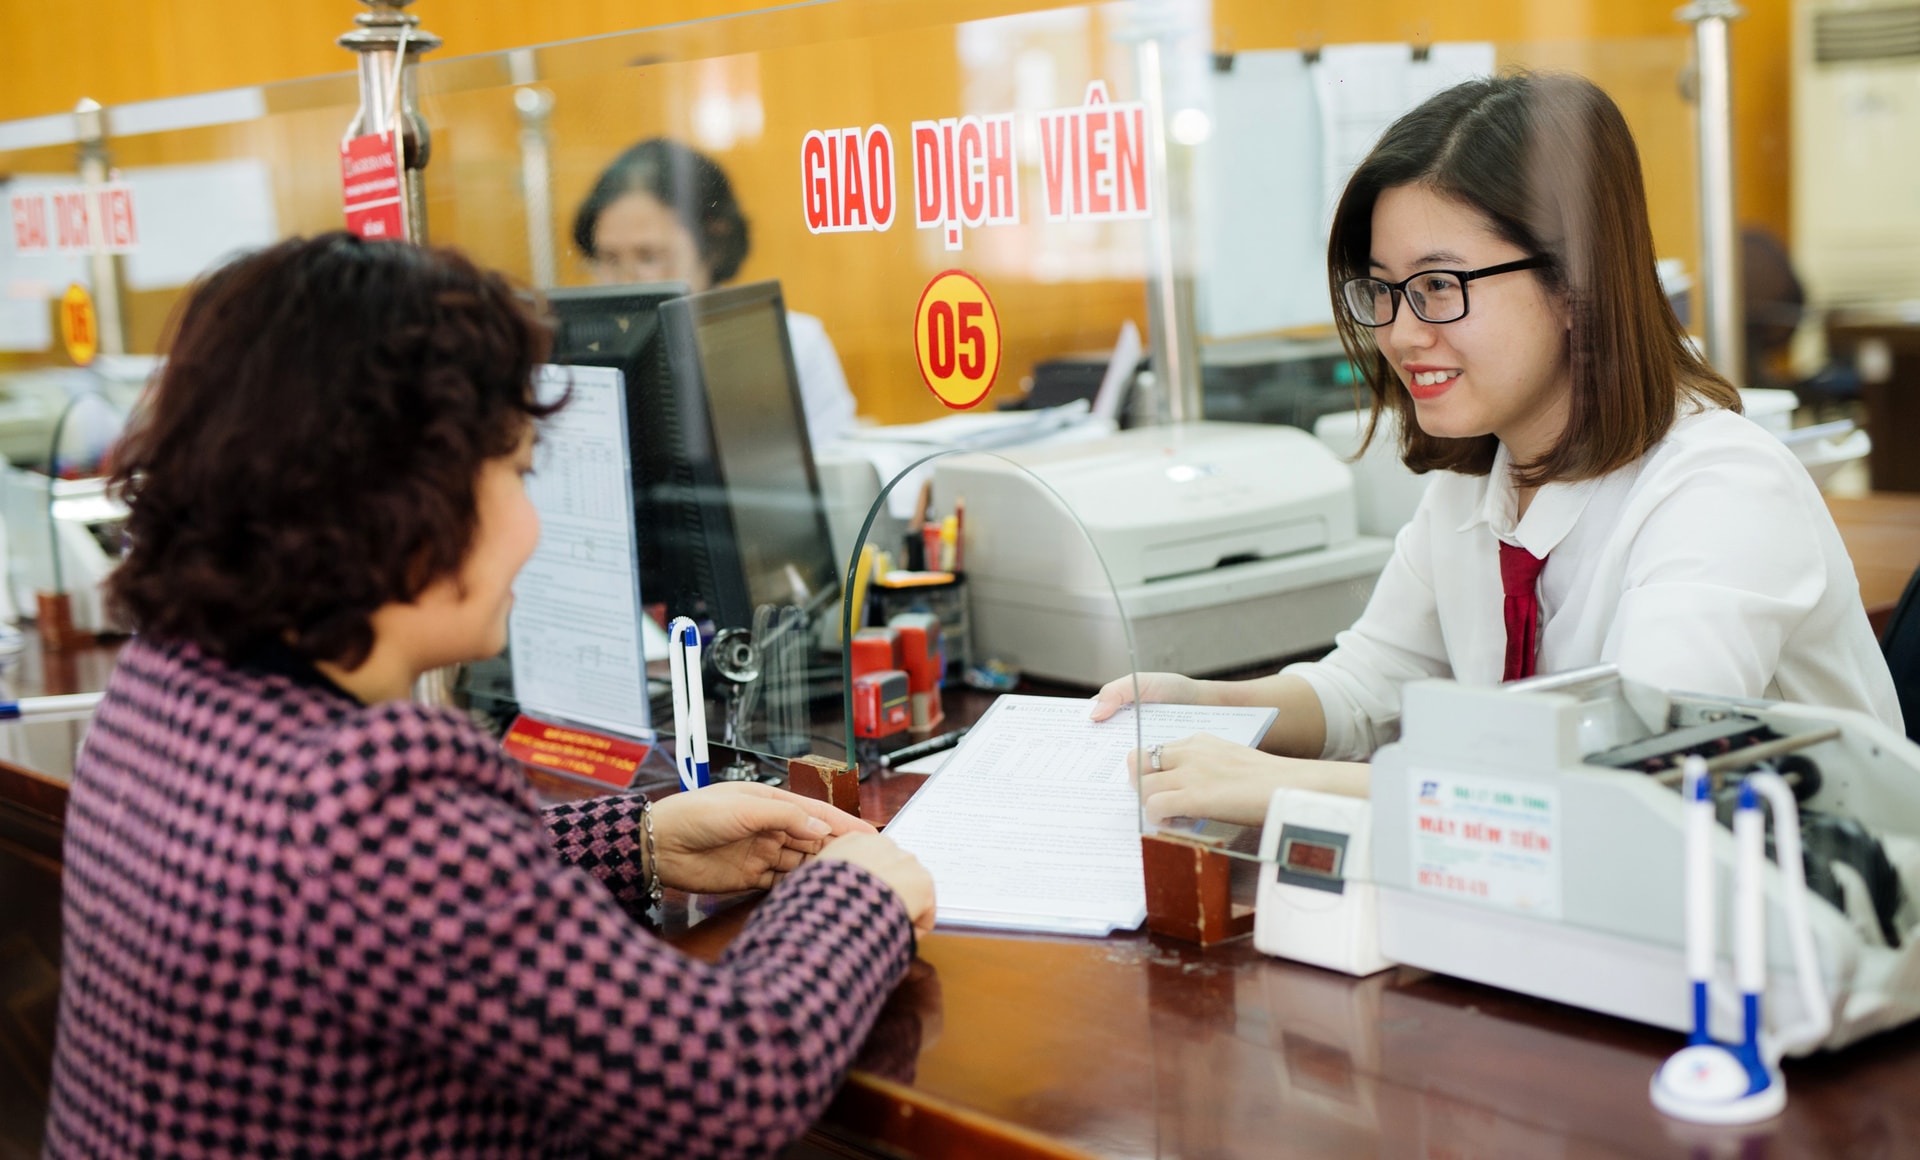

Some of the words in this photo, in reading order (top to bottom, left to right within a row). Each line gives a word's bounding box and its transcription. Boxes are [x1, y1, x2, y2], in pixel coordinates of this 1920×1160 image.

[803, 127, 894, 232] GIAO
[914, 117, 1016, 248] DỊCH
[1039, 83, 1150, 222] VIÊN
[927, 299, 987, 381] 05
